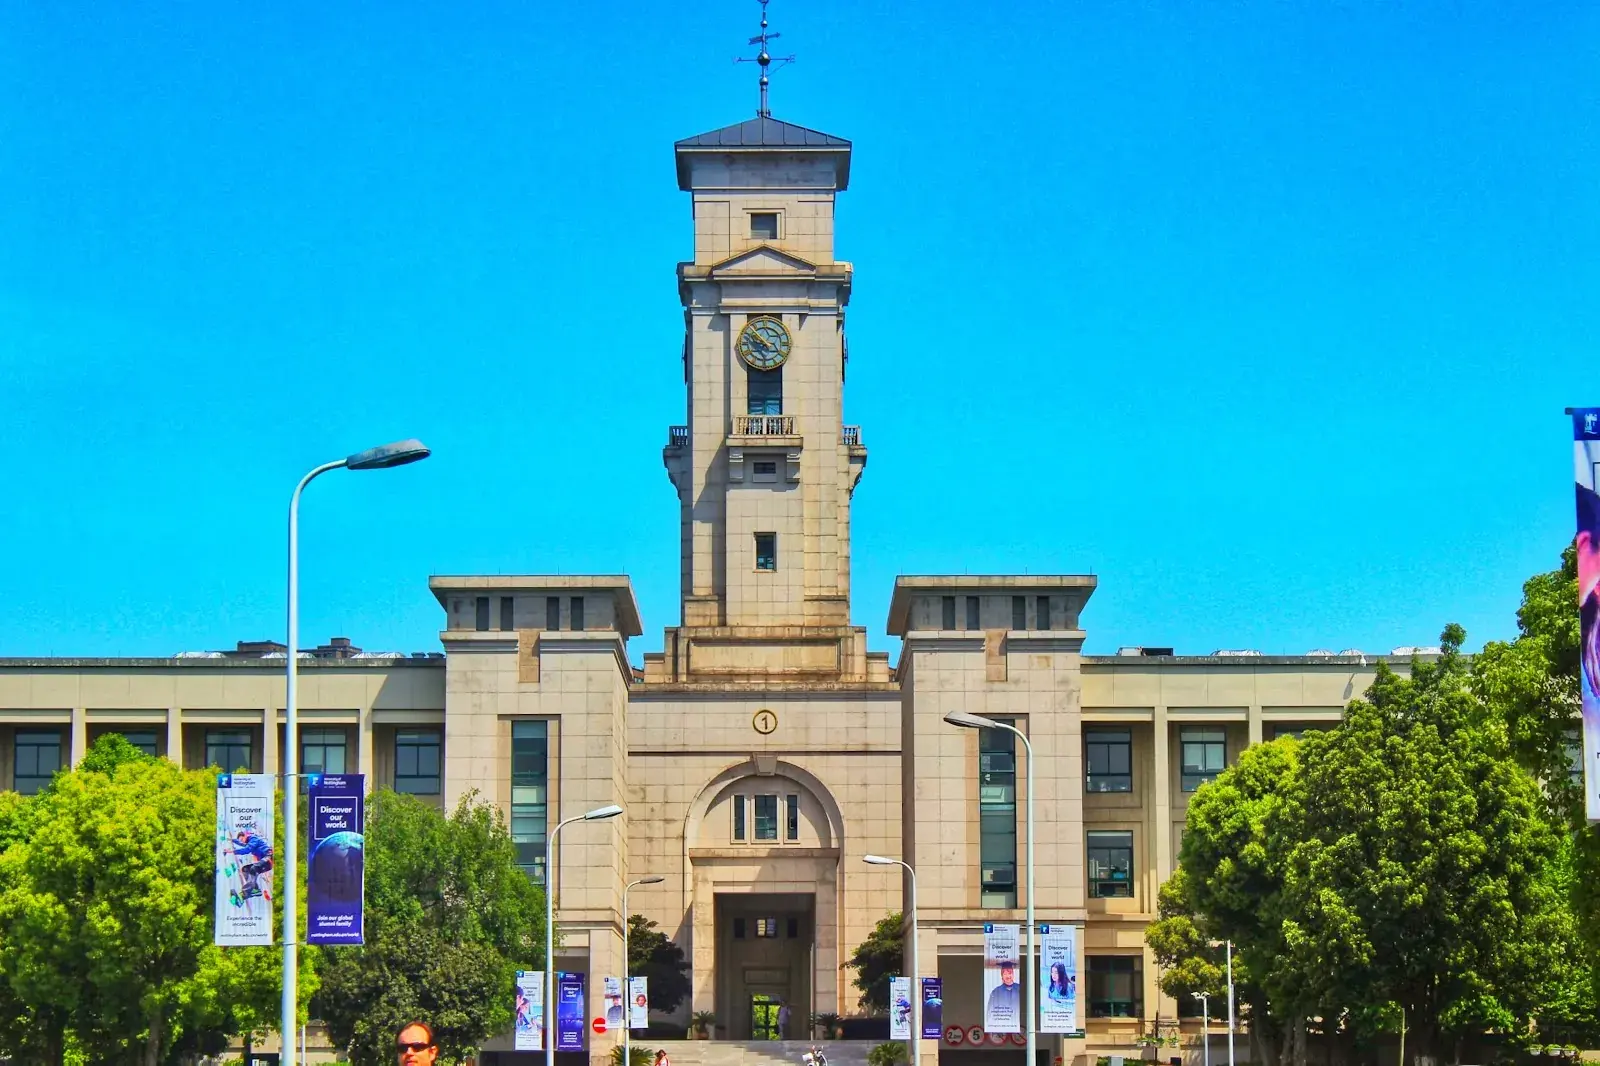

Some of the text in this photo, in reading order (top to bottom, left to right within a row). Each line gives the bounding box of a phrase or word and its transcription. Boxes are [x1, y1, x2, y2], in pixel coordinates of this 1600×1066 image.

[761, 714, 768, 730] 1
[230, 806, 262, 814] Discover
[320, 806, 353, 814] Discover
[235, 821, 257, 829] world
[325, 821, 347, 829] world
[337, 914, 353, 922] global
[973, 1030, 980, 1040] 5
